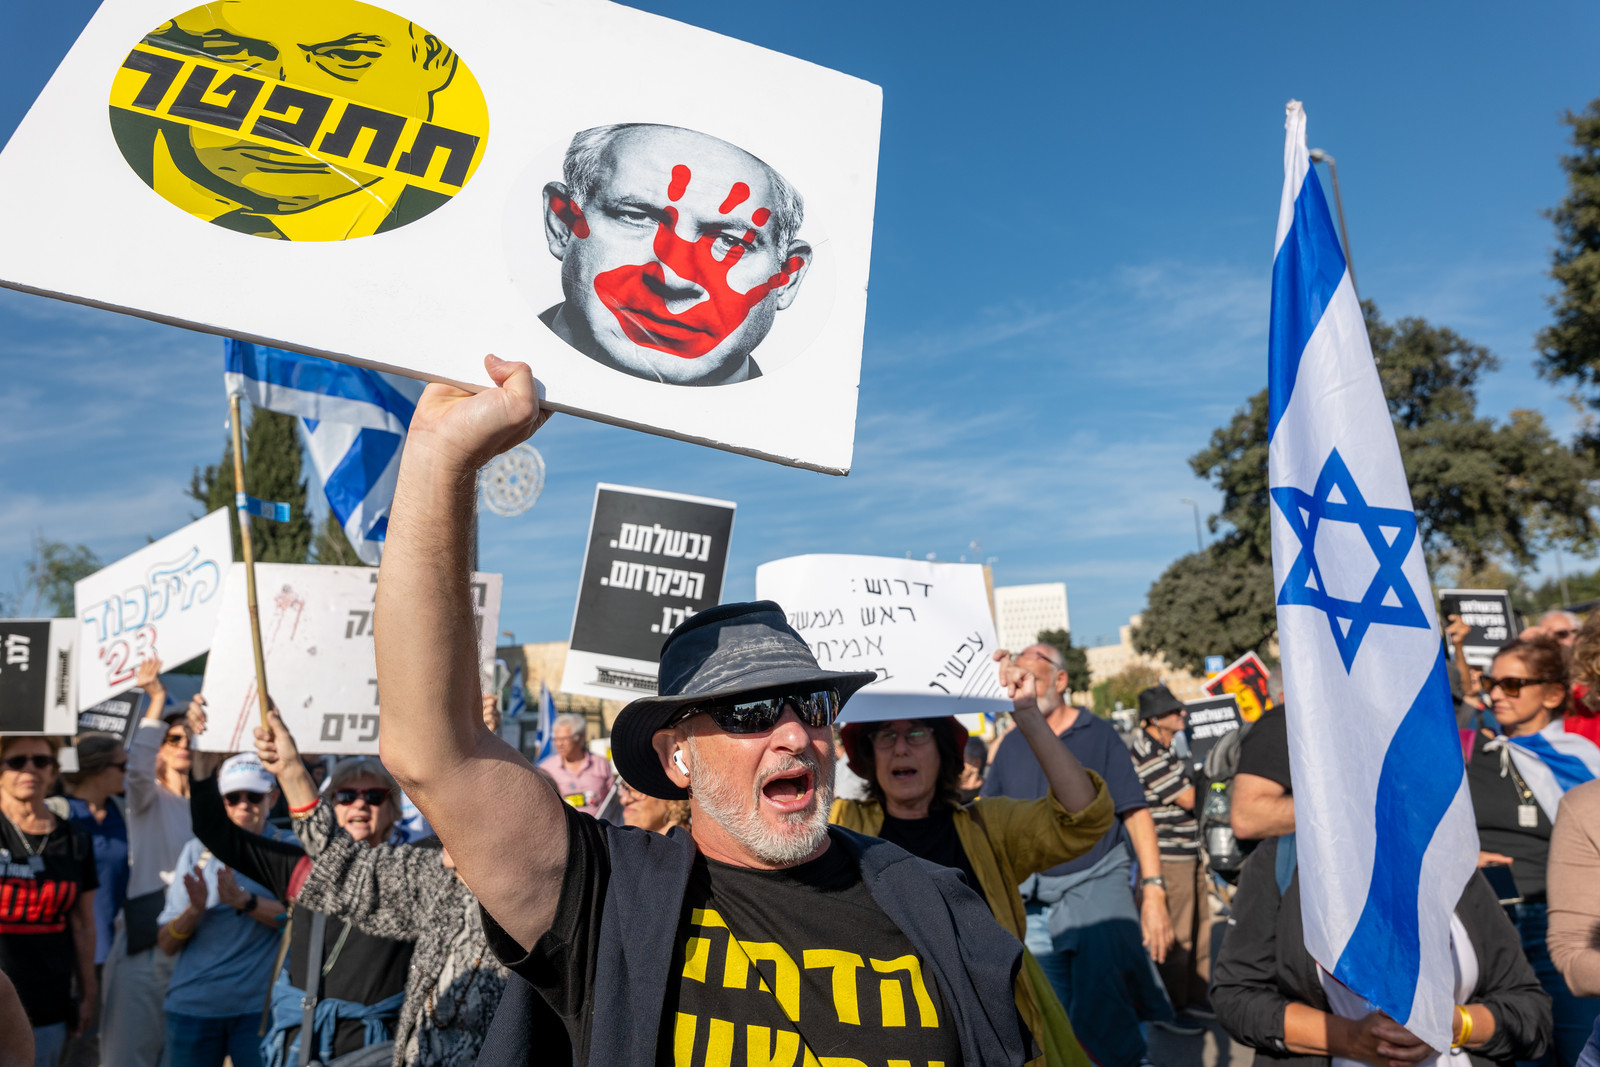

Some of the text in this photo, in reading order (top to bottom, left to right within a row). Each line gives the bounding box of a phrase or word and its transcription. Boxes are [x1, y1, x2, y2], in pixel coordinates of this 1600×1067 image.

[122, 48, 481, 188] תתפטר
[609, 522, 712, 562] נכשלתם.
[600, 560, 706, 600] הפקרתם.
[785, 606, 917, 631] ראש ממשל
[929, 631, 984, 694] עכשיו
[0, 877, 77, 923] OW!
